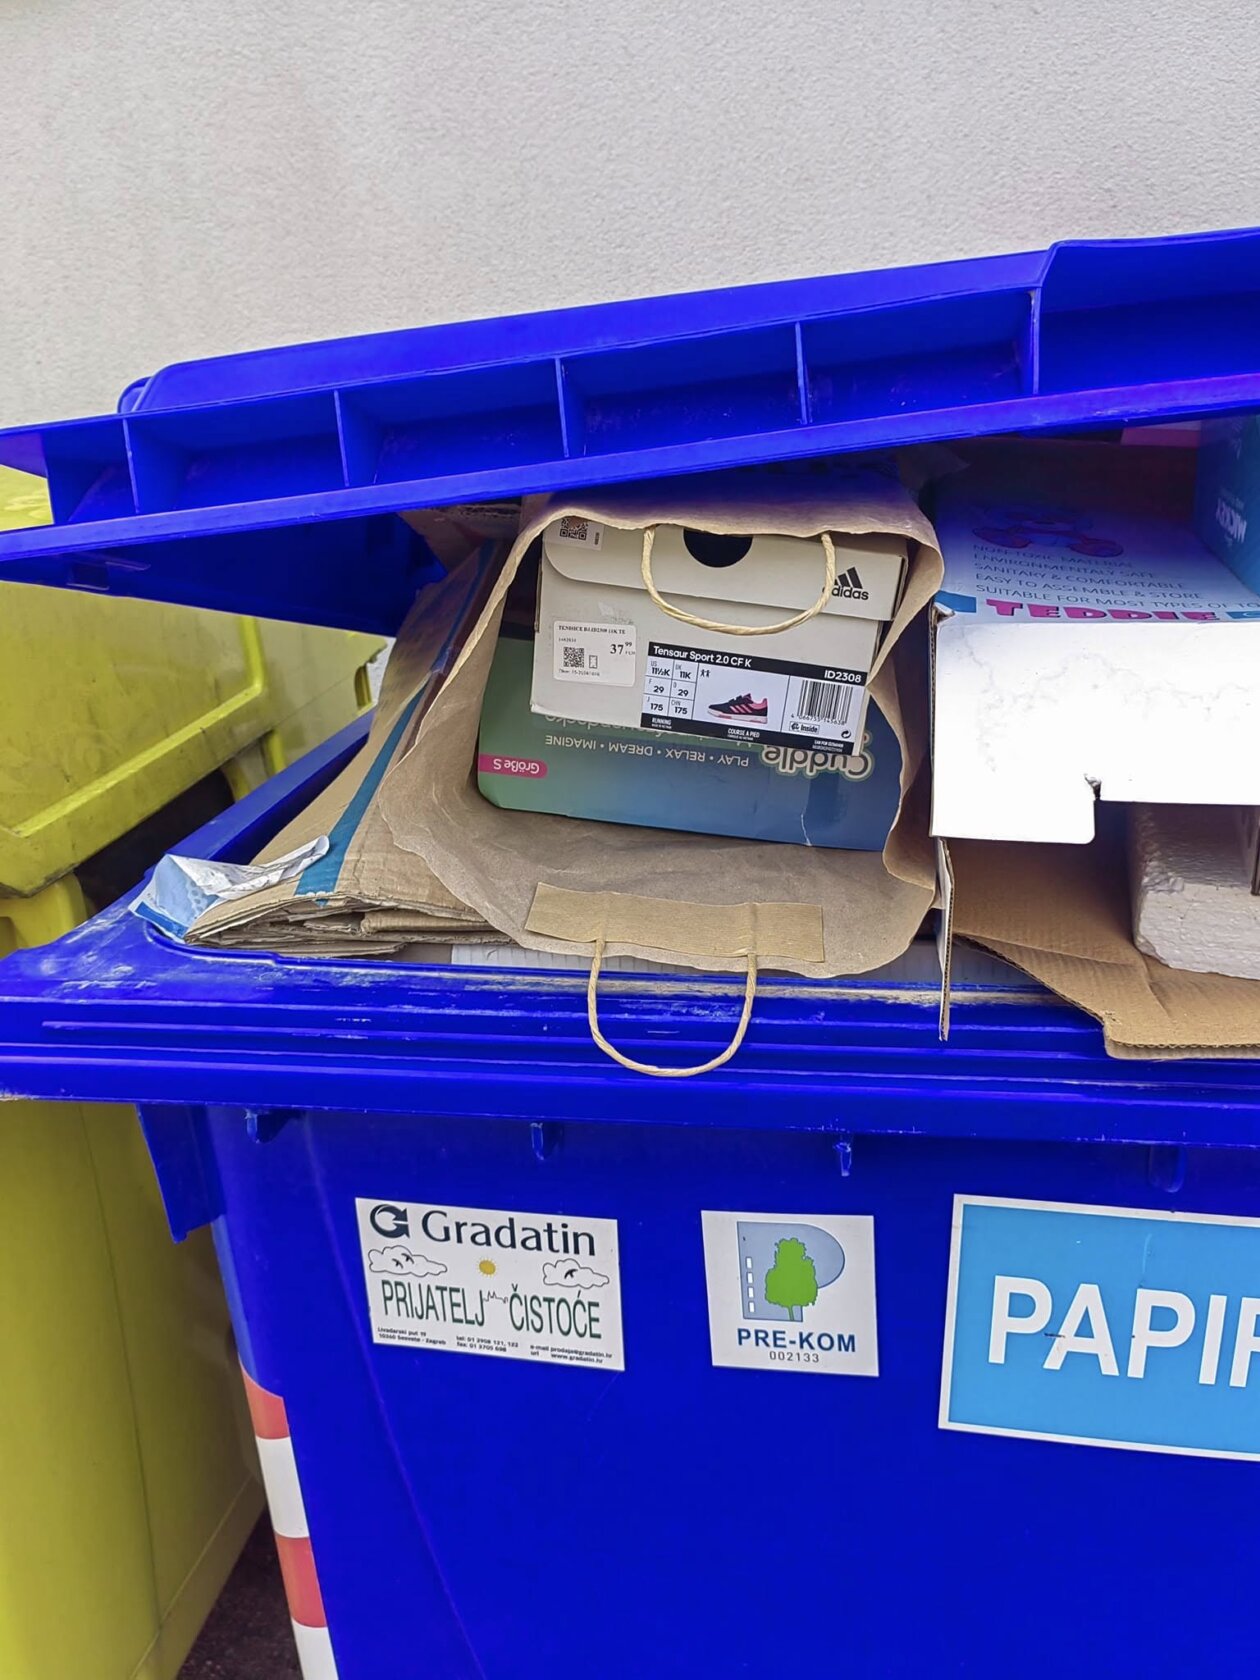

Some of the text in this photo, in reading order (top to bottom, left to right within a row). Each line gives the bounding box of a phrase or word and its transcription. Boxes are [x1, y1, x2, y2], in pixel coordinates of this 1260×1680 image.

[974, 563, 1046, 578] SANITARY
[1066, 576, 1185, 590] COMFORTABLE
[975, 573, 1011, 584] EASY
[1016, 580, 1037, 588] TO
[1042, 583, 1129, 597] ASSEMBLE
[1149, 591, 1204, 600] STORE
[976, 584, 1051, 600] SUITABLE
[1057, 595, 1090, 603] FOR
[1095, 597, 1145, 607] MOST
[1152, 601, 1203, 609] TYPES
[609, 643, 624, 655] 37
[653, 646, 752, 667] Tensaur Sport 2.0 CF K
[680, 671, 691, 680] 11K
[824, 669, 862, 683] ID2308
[653, 685, 689, 697] 29 29
[650, 702, 688, 715] 175 175
[651, 717, 672, 726] RUNNING
[800, 722, 818, 733] Inside
[545, 734, 749, 767] PLAY RELAX DREAM IMAGINE
[493, 758, 540, 774] Größe S
[421, 1210, 595, 1256] Gradatin
[381, 1279, 602, 1339] PRIJATELJ ČISTOĆE
[737, 1327, 856, 1353] PRE-KOM
[769, 1350, 820, 1363] 002133
